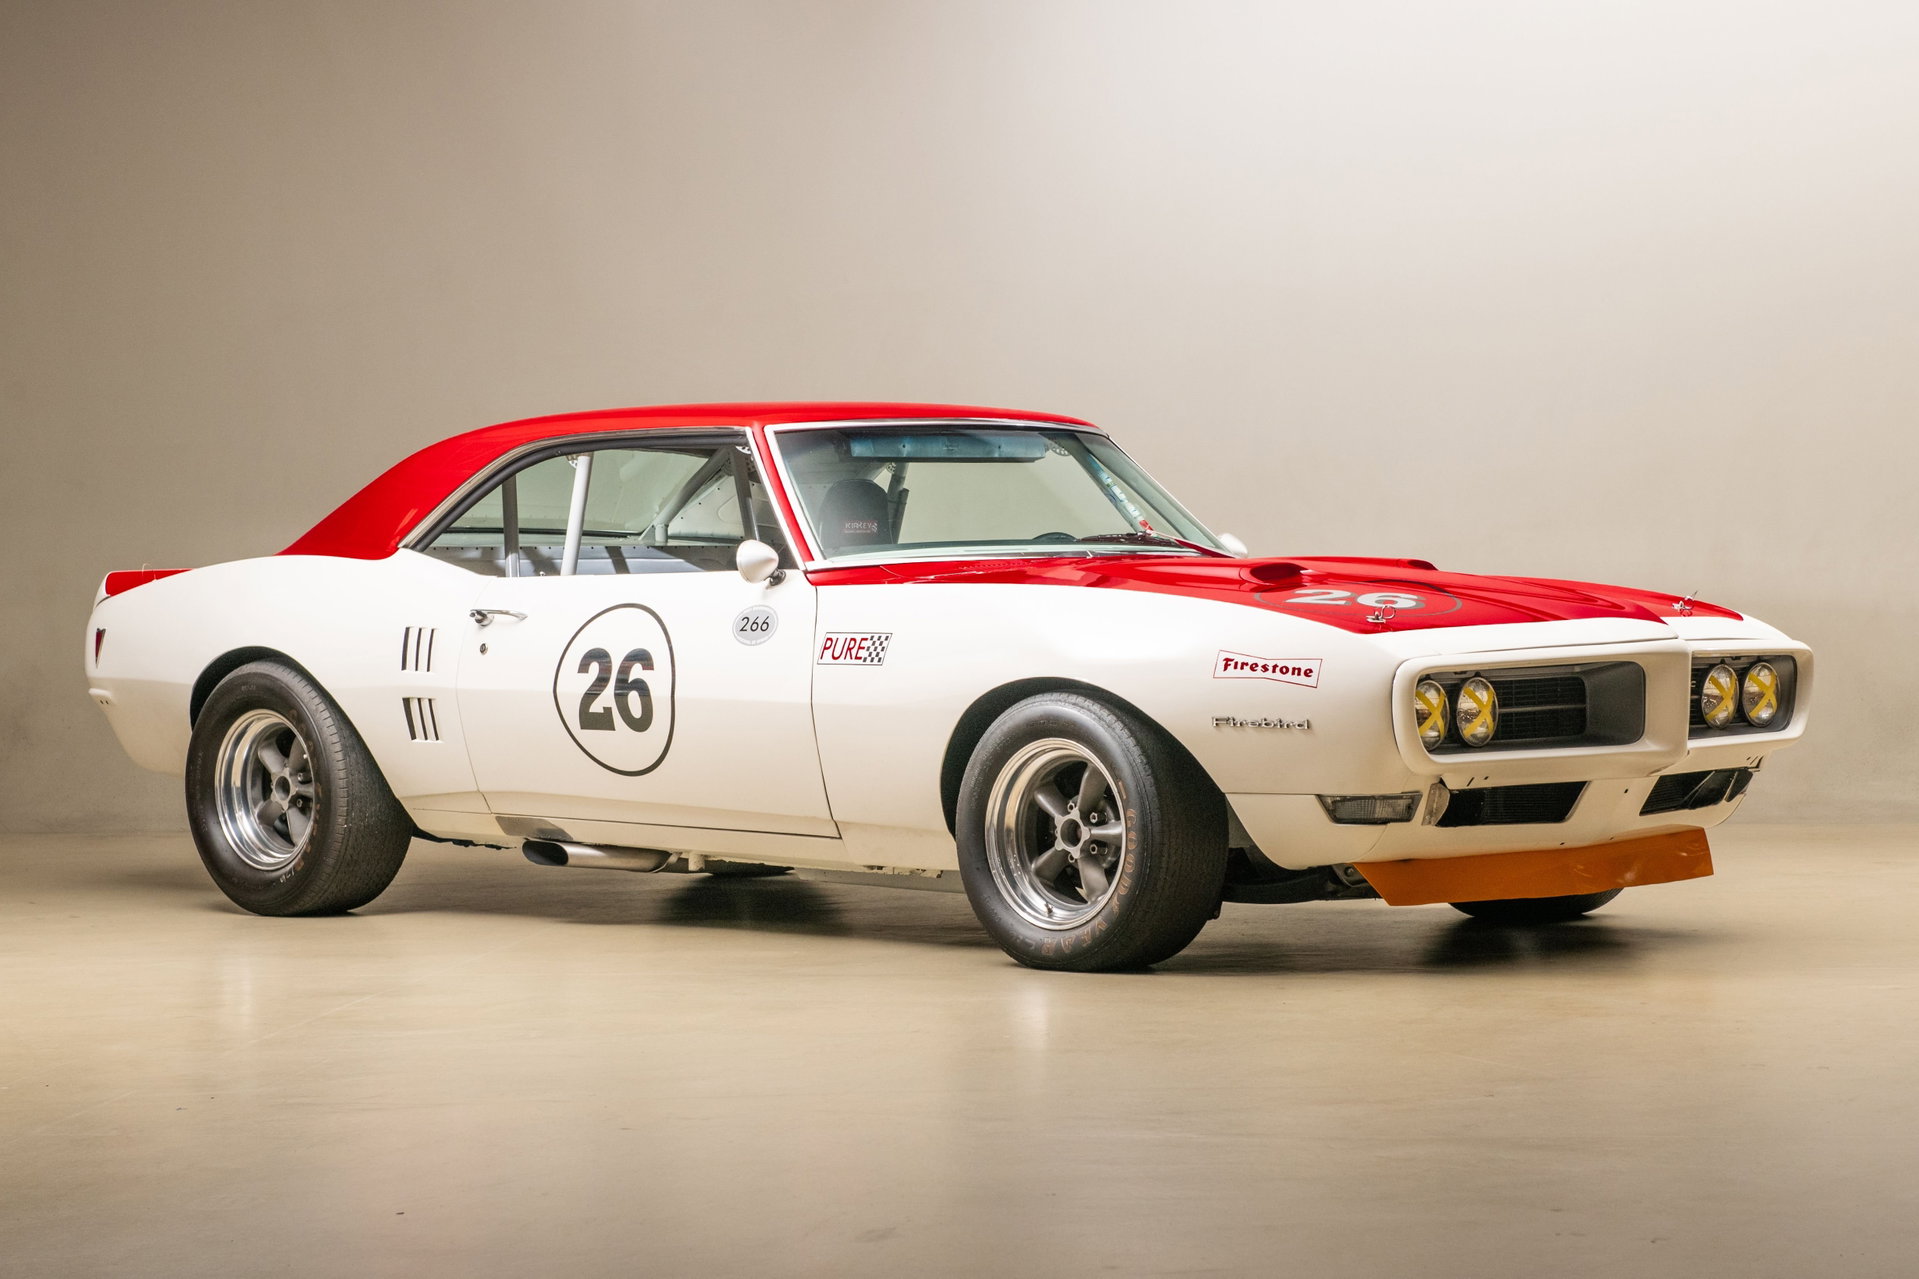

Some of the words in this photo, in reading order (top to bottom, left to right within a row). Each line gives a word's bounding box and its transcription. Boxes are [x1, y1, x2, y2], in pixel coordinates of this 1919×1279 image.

[1284, 589, 1424, 610] 26
[739, 615, 770, 633] 266
[820, 636, 869, 661] PURE
[1222, 657, 1315, 678] Firestone
[577, 647, 655, 733] 26
[1211, 715, 1312, 731] Firebird
